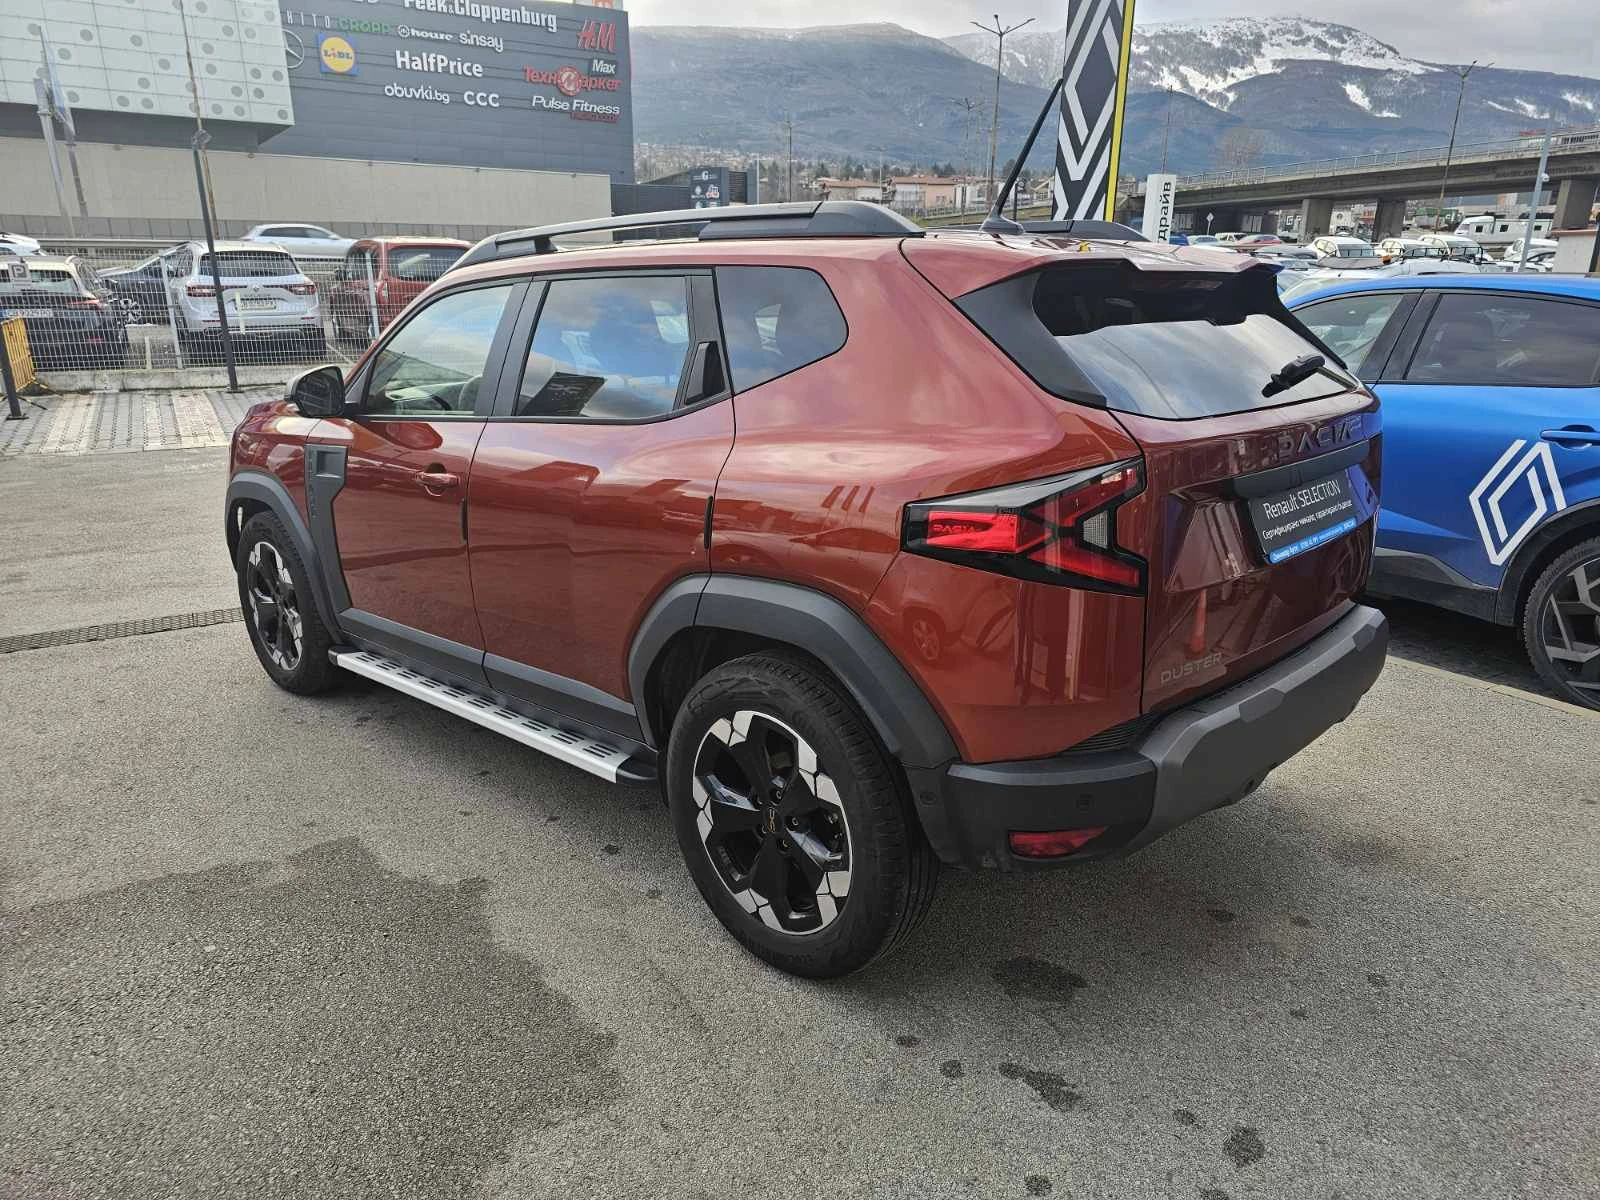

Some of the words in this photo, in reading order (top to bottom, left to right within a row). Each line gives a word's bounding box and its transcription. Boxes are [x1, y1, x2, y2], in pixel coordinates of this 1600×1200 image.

[338, 16, 391, 34] CROPP
[459, 30, 504, 53] sinsay
[395, 49, 484, 77] HalfPrice
[593, 59, 616, 74] Max
[384, 83, 450, 104] obuvki.bg
[463, 90, 500, 108] CCC
[532, 95, 570, 111] Pulse
[573, 99, 621, 114] Fitness
[1158, 181, 1173, 241] драйв
[1263, 494, 1300, 520] Renault
[1298, 479, 1341, 507] SELECTION
[1160, 652, 1223, 683] DUSTER
